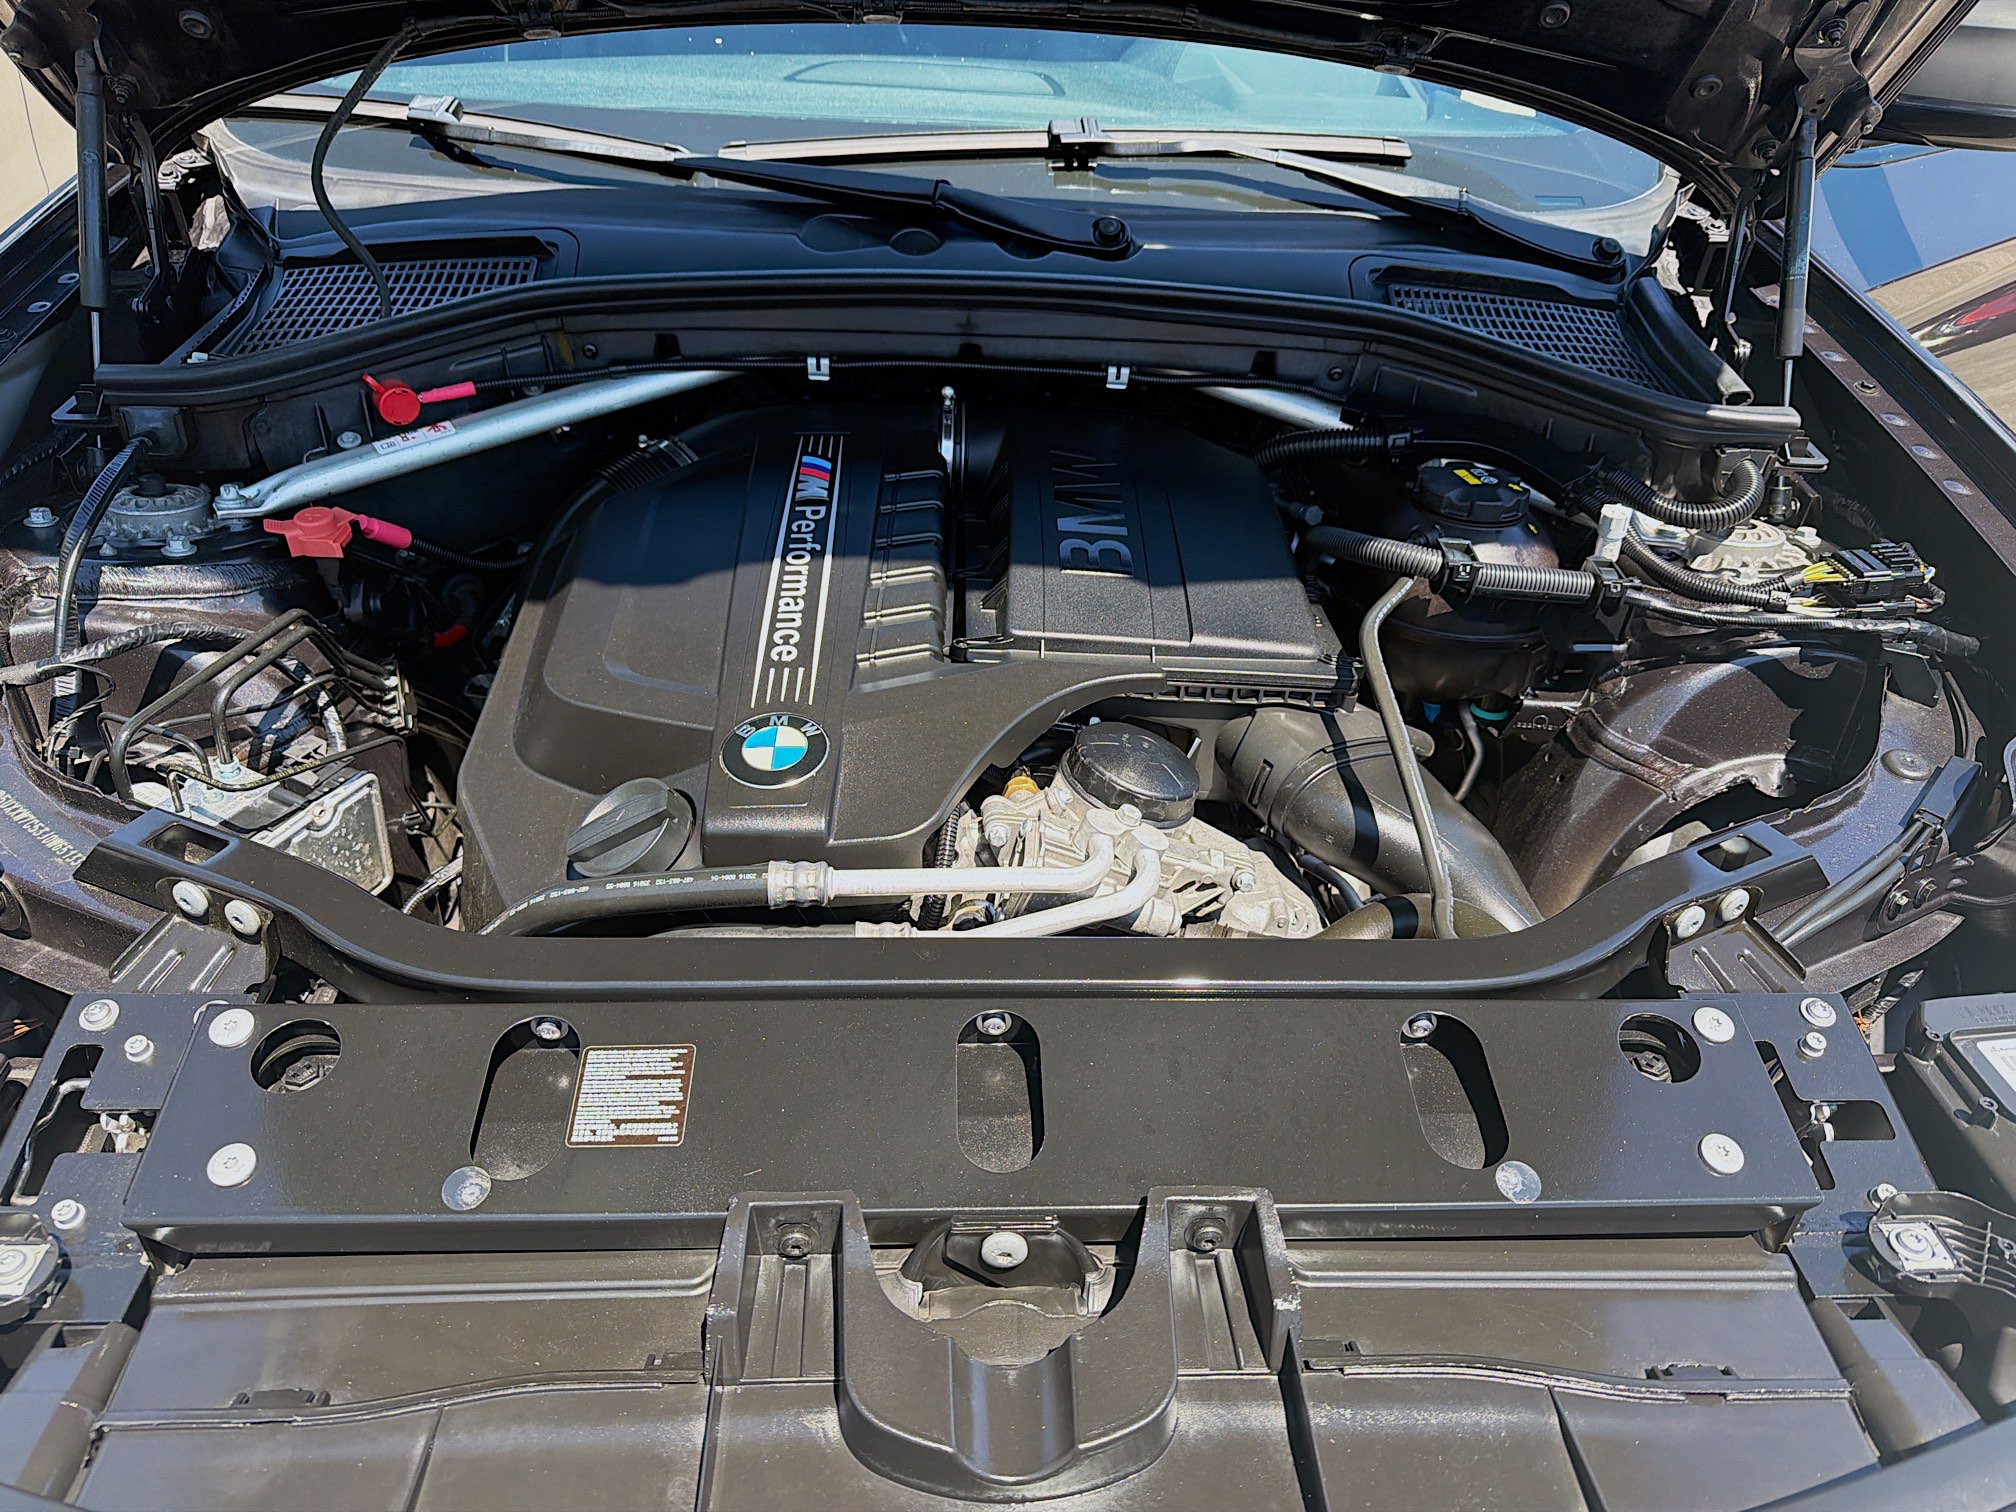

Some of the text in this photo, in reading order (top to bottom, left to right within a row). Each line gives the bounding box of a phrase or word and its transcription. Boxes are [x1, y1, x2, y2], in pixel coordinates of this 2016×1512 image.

[769, 474, 831, 663] M Performance
[1050, 450, 1134, 578] BMW
[735, 715, 822, 739] BMW
